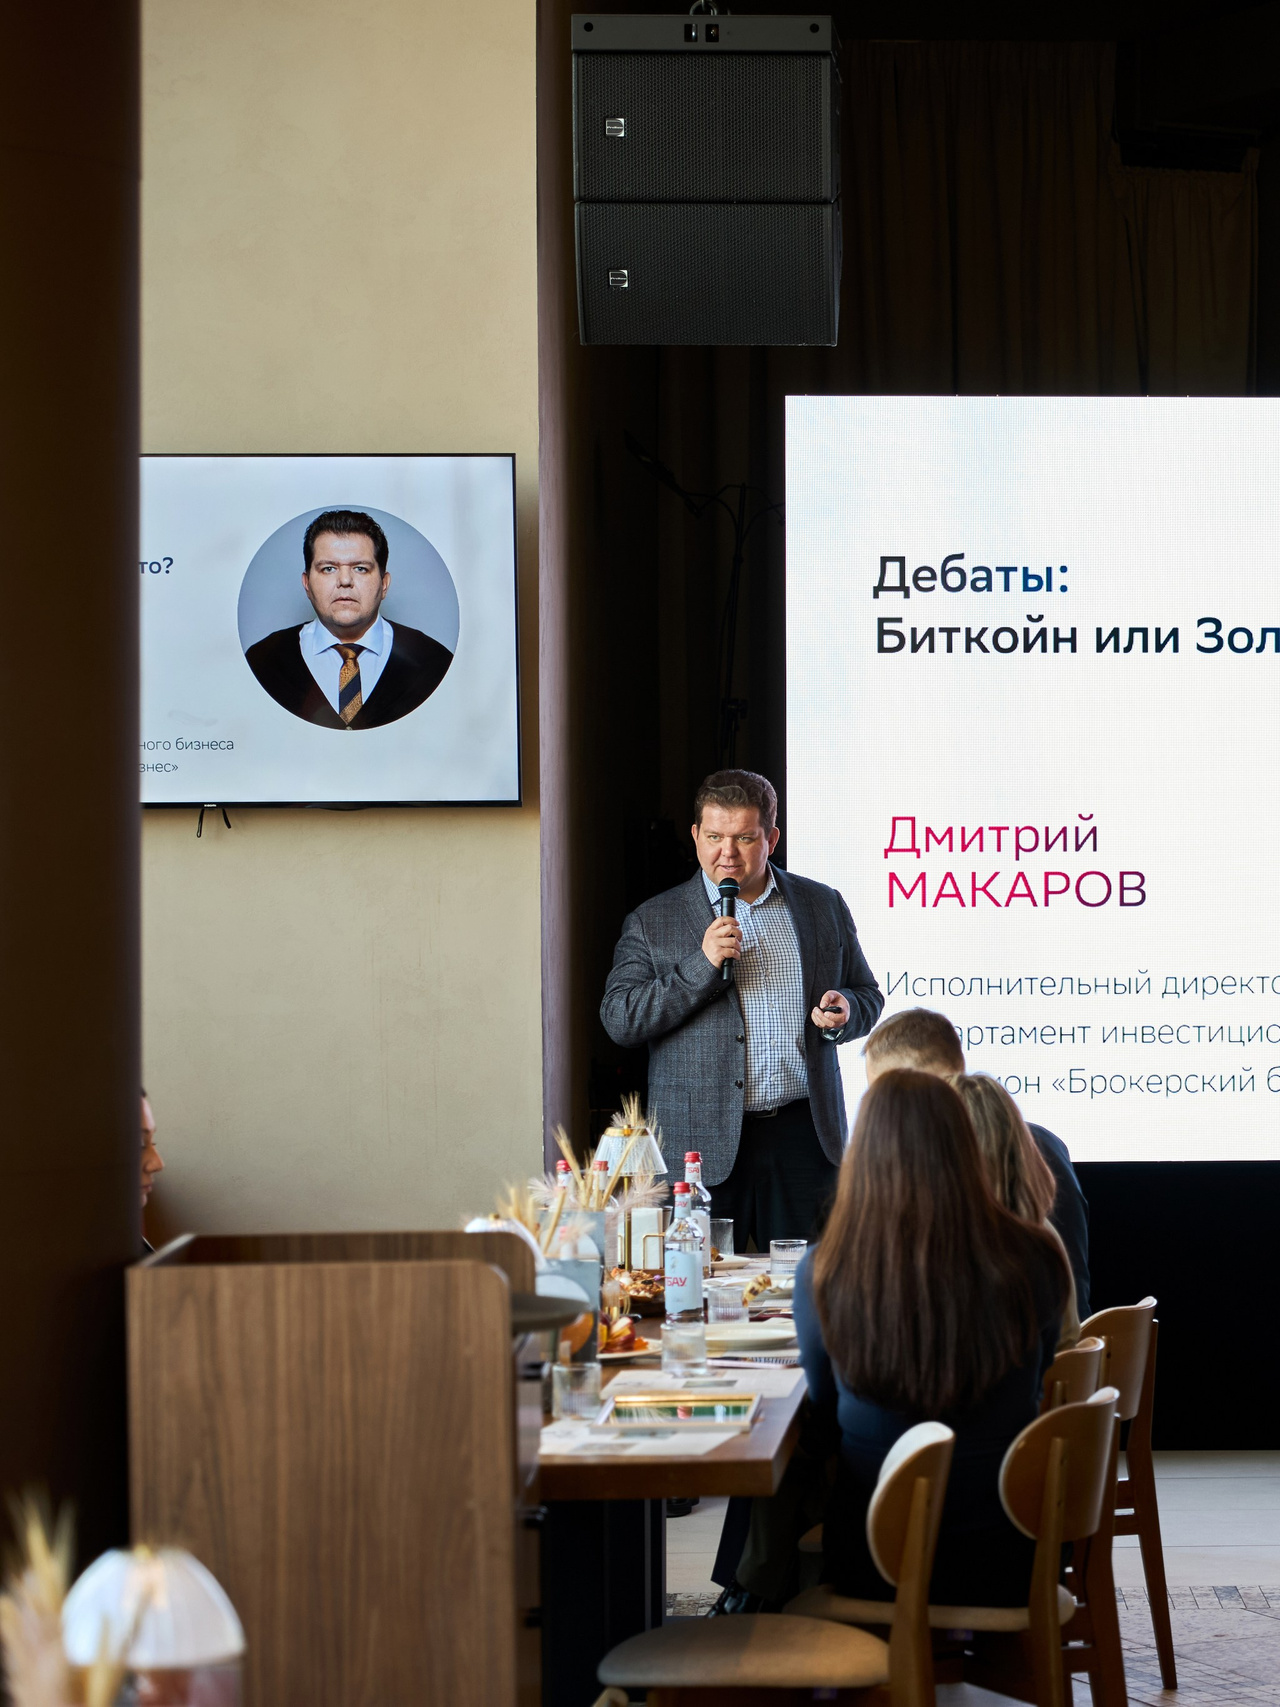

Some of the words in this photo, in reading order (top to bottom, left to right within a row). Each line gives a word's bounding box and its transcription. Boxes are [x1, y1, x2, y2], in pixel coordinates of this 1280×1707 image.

[873, 553, 1068, 599] Дебаты:
[877, 614, 1077, 653] Биткойн
[1096, 627, 1179, 653] или
[175, 737, 235, 751] бизнеса
[884, 814, 1097, 861] Дмитрий
[889, 871, 1146, 908] МАКАРОВ
[887, 970, 1150, 996] Исполнительный
[997, 1075, 1040, 1095] он
[1052, 1067, 1254, 1099] «Брокерский
